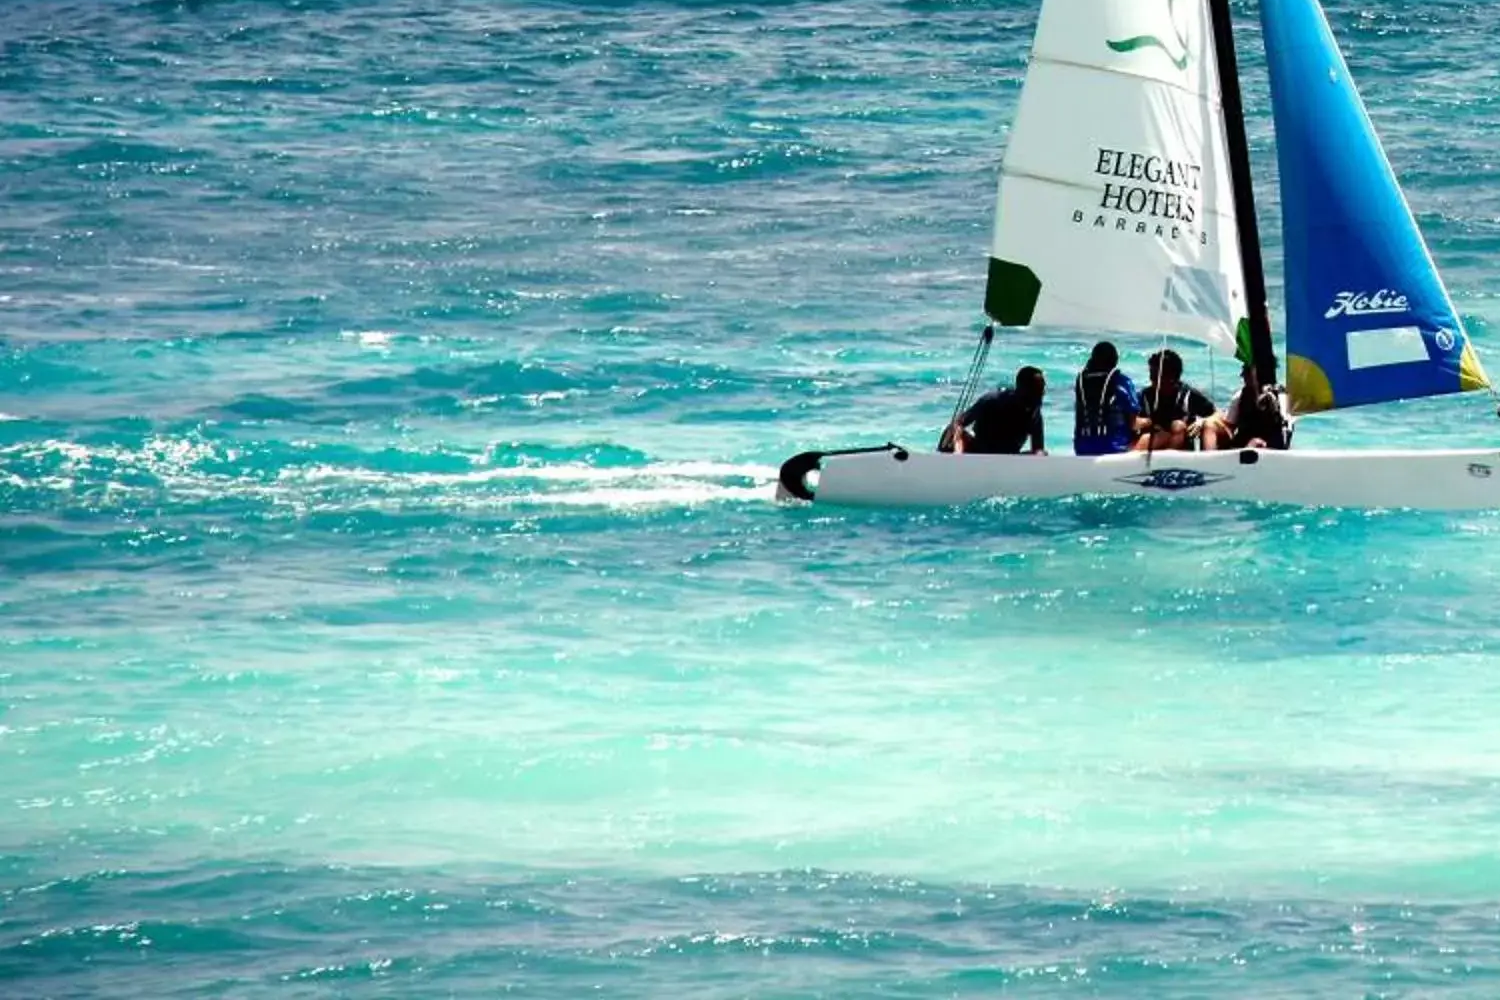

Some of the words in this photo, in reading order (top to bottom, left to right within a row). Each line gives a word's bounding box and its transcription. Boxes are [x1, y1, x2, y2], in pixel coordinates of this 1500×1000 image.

[1094, 147, 1201, 190] ELEGANT
[1100, 183, 1196, 223] HOTELS
[1072, 209, 1207, 245] BARBADS
[1324, 289, 1410, 319] Hobie
